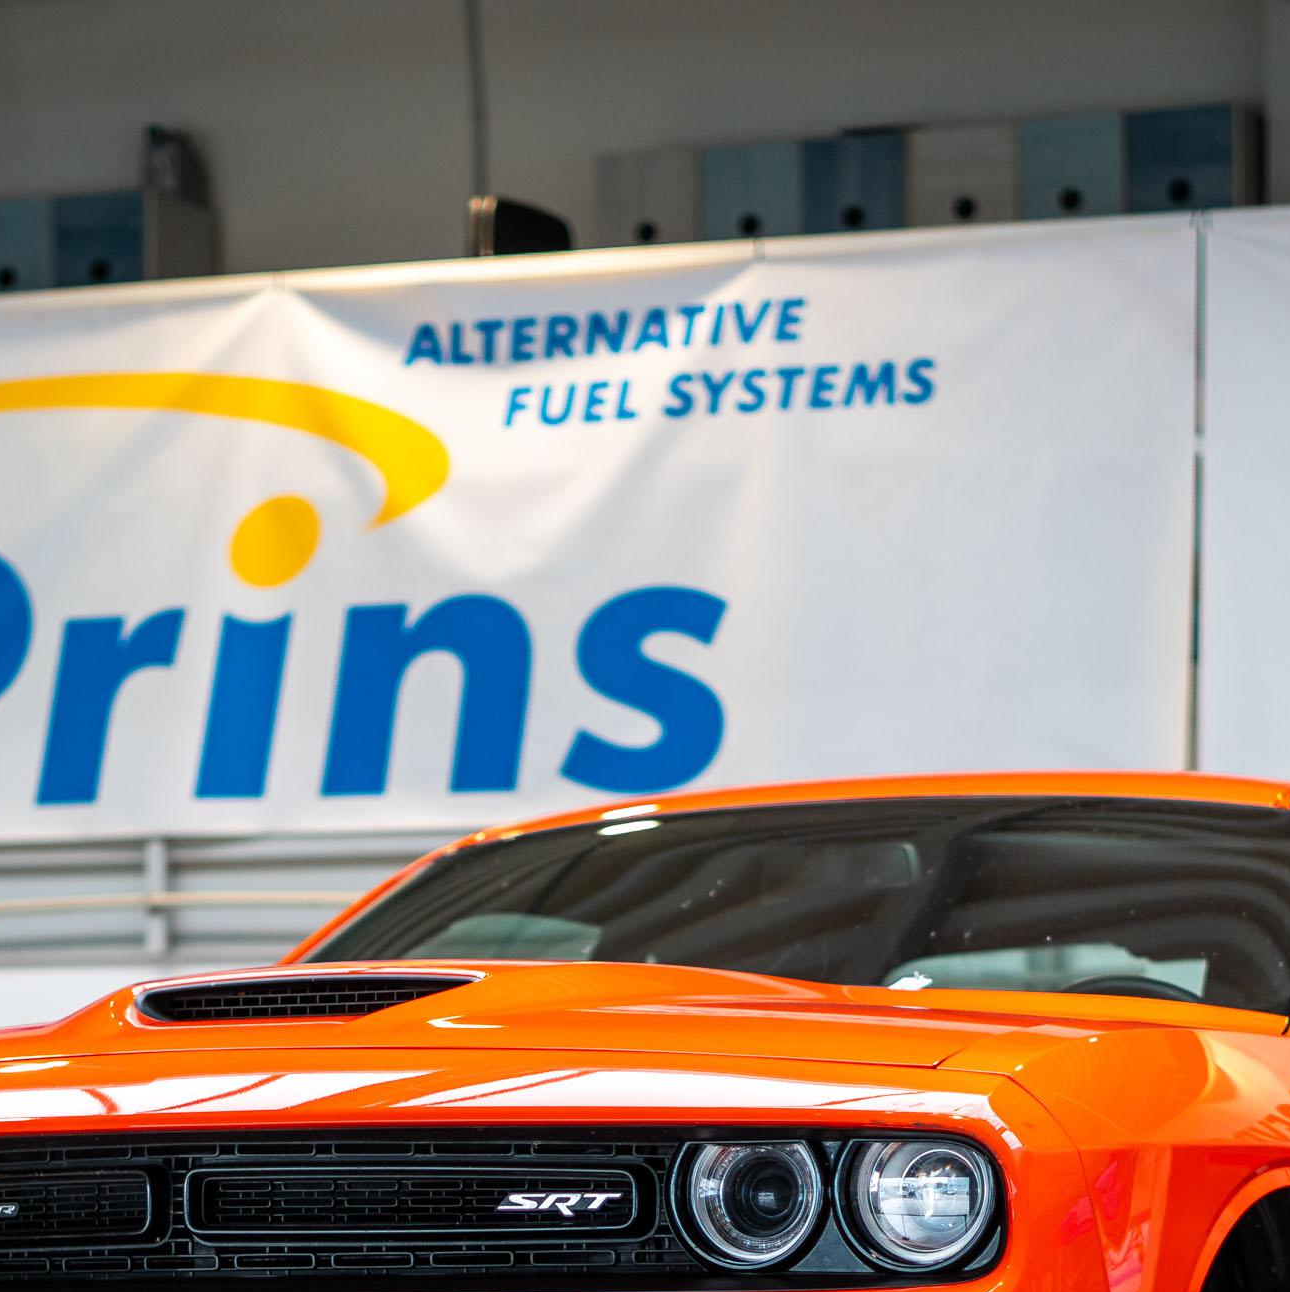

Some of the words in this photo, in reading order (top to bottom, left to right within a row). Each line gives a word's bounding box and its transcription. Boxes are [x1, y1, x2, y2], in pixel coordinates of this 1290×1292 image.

[405, 297, 808, 366] ALTERNATIVE
[505, 380, 638, 427] FUEL
[662, 357, 937, 418] SYSTEMS
[497, 1192, 622, 1217] SRT
